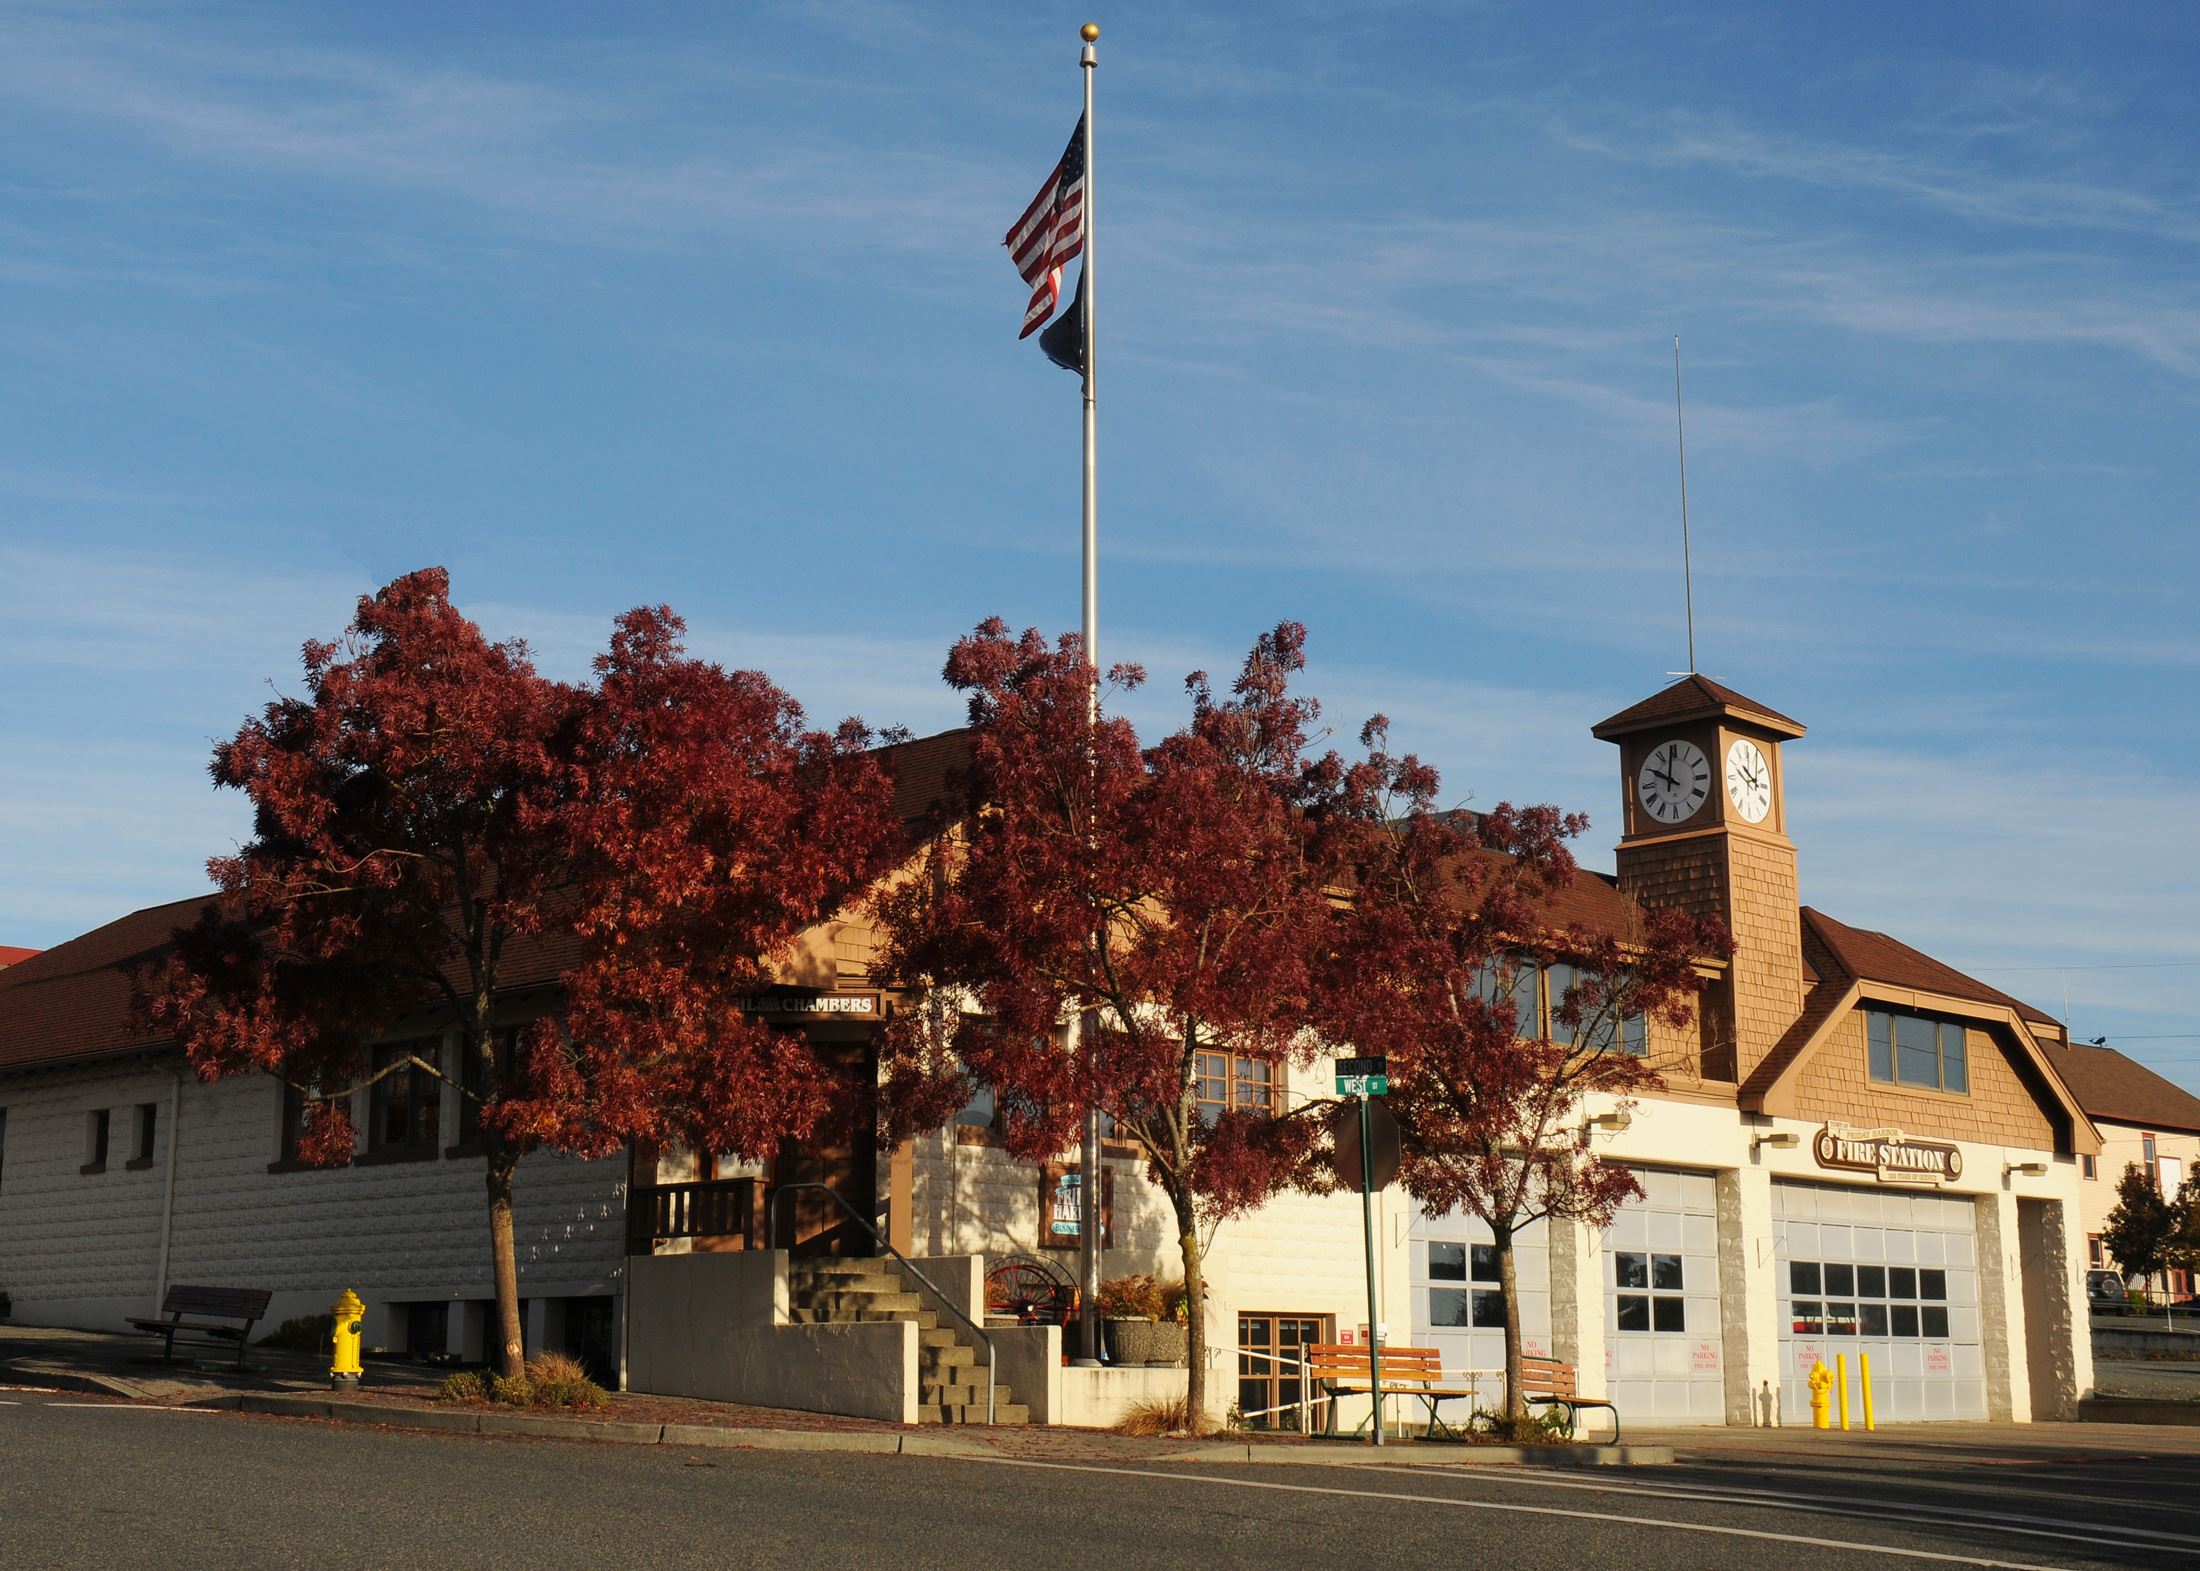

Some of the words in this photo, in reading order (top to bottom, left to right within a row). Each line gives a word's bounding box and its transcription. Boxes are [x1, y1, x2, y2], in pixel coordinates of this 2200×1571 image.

[782, 998, 873, 1013] CHAMBERS
[1338, 1060, 1373, 1073] SECOND
[1344, 1079, 1367, 1093] WEST
[1846, 1131, 1871, 1140] FRIDAY
[1872, 1128, 1899, 1138] HARBOR
[1836, 1140, 1876, 1165] FIRE
[1879, 1144, 1945, 1171] STATION
[1692, 1352, 1718, 1360] PARKING
[1798, 1352, 1822, 1360] PARKING
